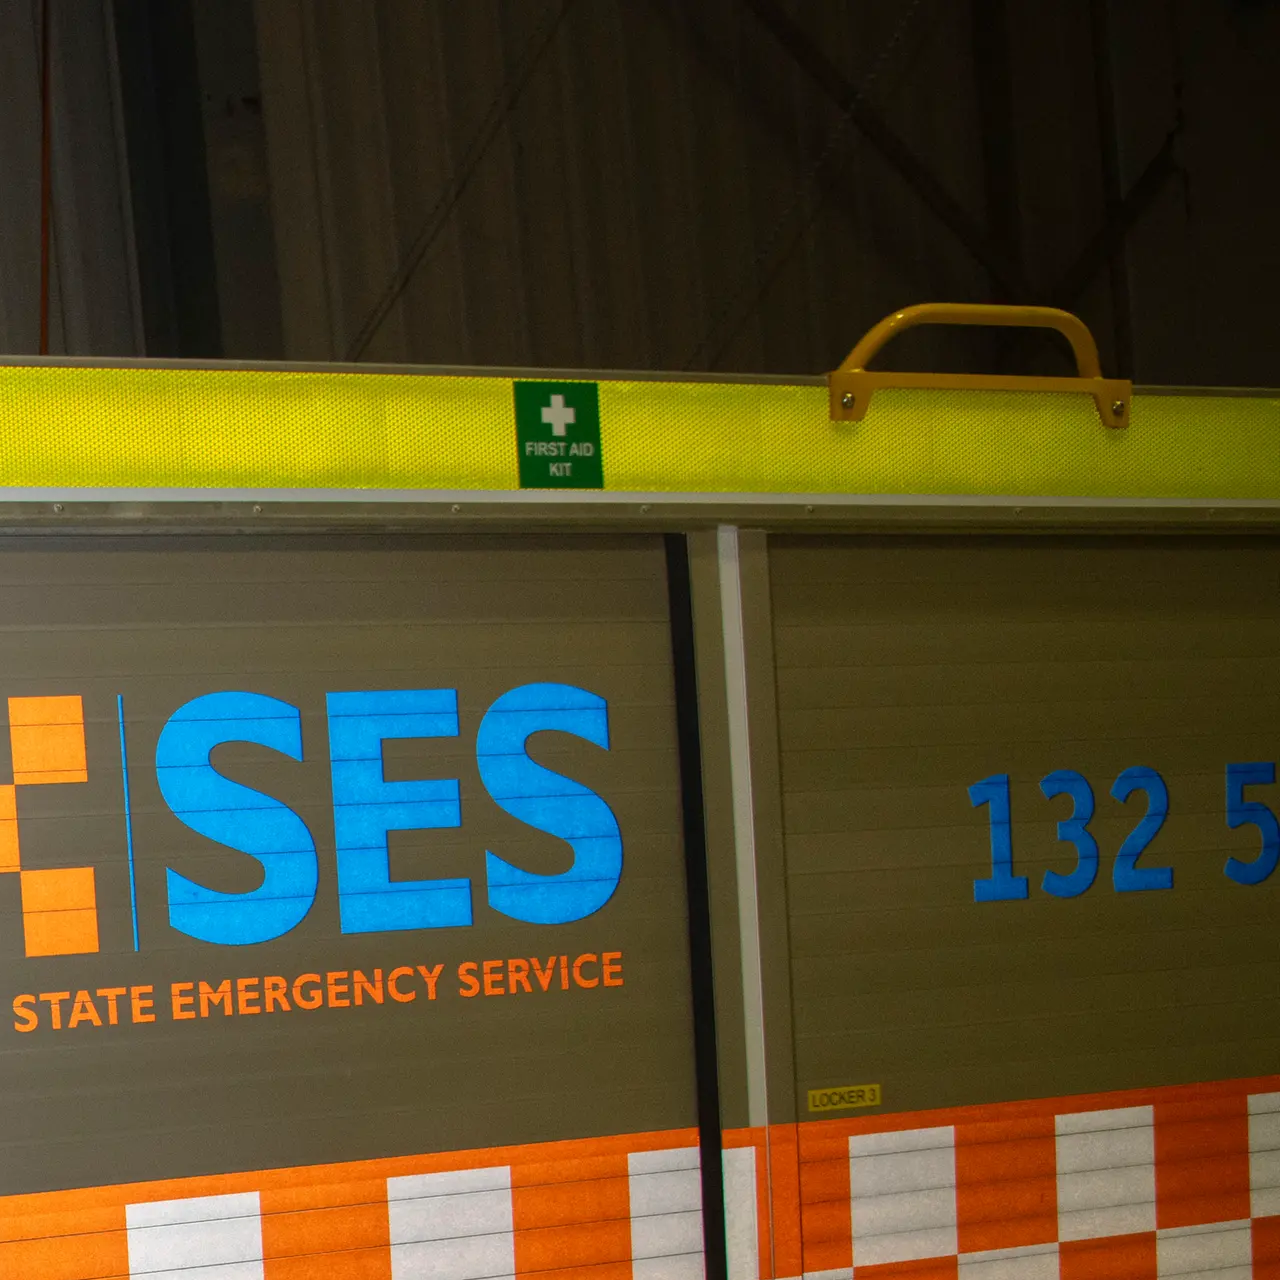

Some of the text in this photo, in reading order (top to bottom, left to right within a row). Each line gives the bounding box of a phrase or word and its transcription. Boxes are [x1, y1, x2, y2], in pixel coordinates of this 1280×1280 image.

[525, 441, 595, 457] FIRST AID
[549, 462, 572, 477] KIT
[155, 681, 624, 946] SES
[967, 761, 1280, 902] 132 5
[12, 984, 156, 1033] STATE
[170, 963, 446, 1021] EMERGENCY
[457, 951, 625, 998] SERVICE
[812, 1087, 876, 1108] LOCKER 3
